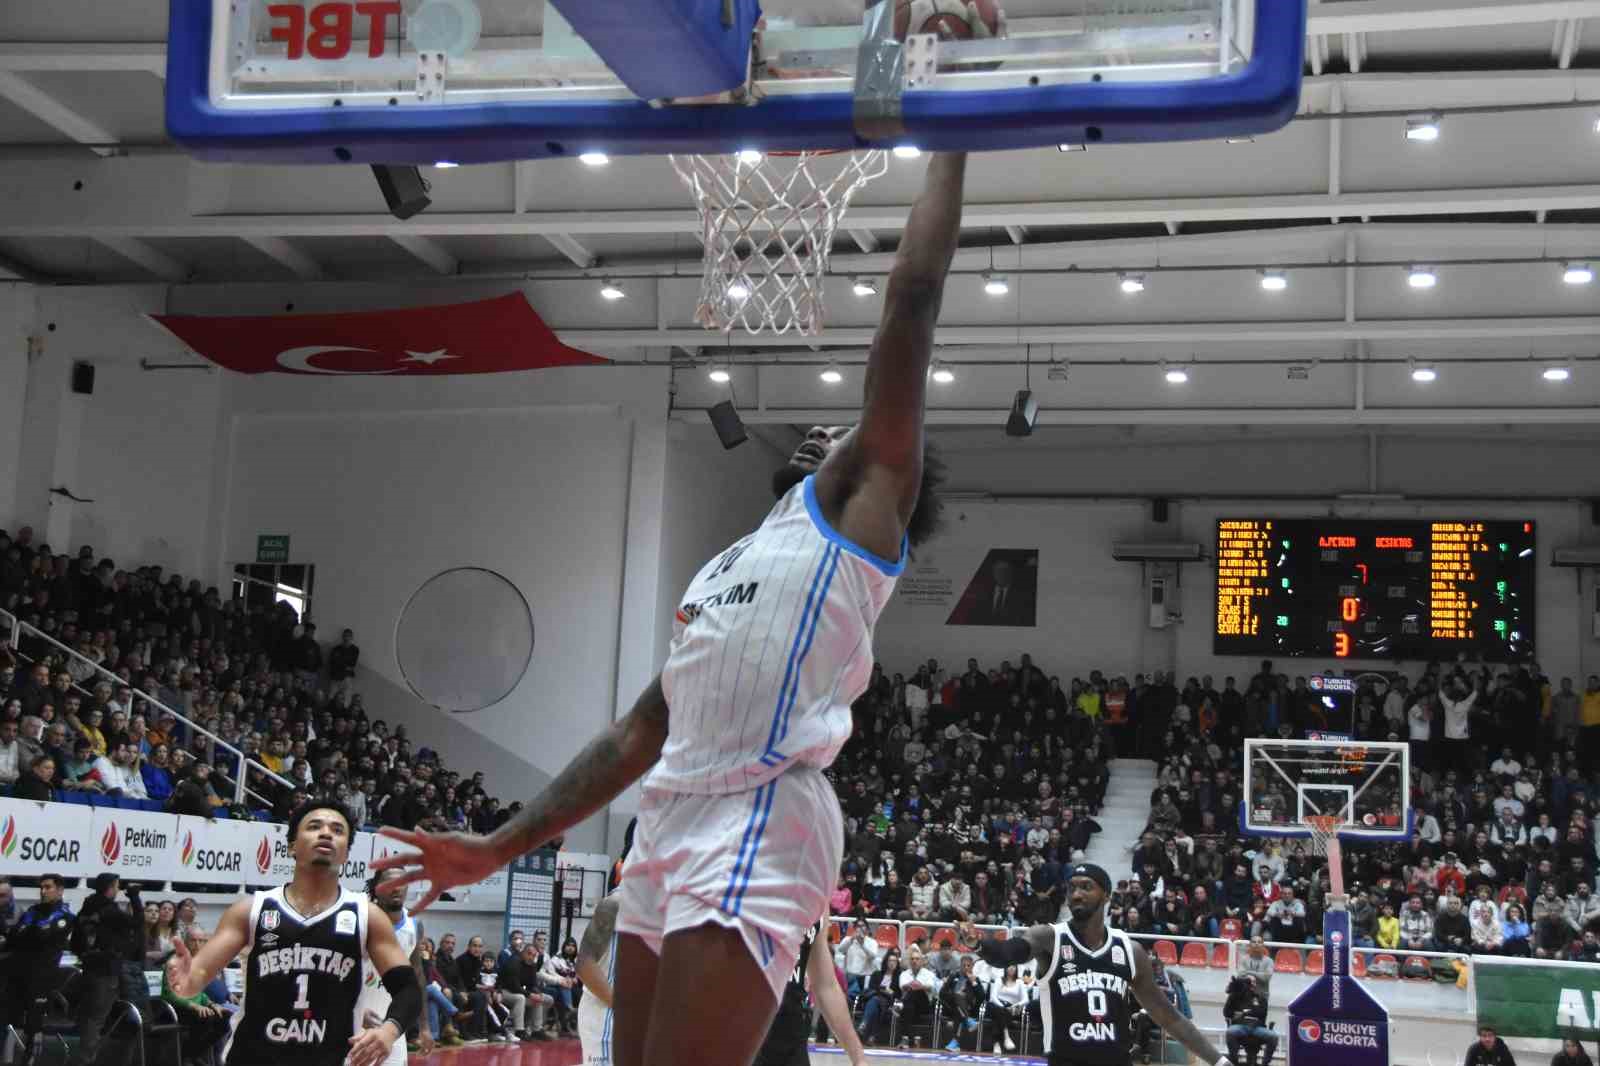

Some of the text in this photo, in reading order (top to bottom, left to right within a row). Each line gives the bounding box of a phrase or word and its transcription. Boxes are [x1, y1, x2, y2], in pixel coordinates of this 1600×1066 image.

[1343, 598, 1357, 621] 0
[1336, 633, 1349, 656] 3
[20, 836, 81, 862] SOCAR
[124, 827, 167, 849] Petkim
[121, 854, 152, 866] SPOR
[195, 850, 241, 872] SOCAR
[293, 973, 310, 1009] 1
[1087, 990, 1107, 1016] 0
